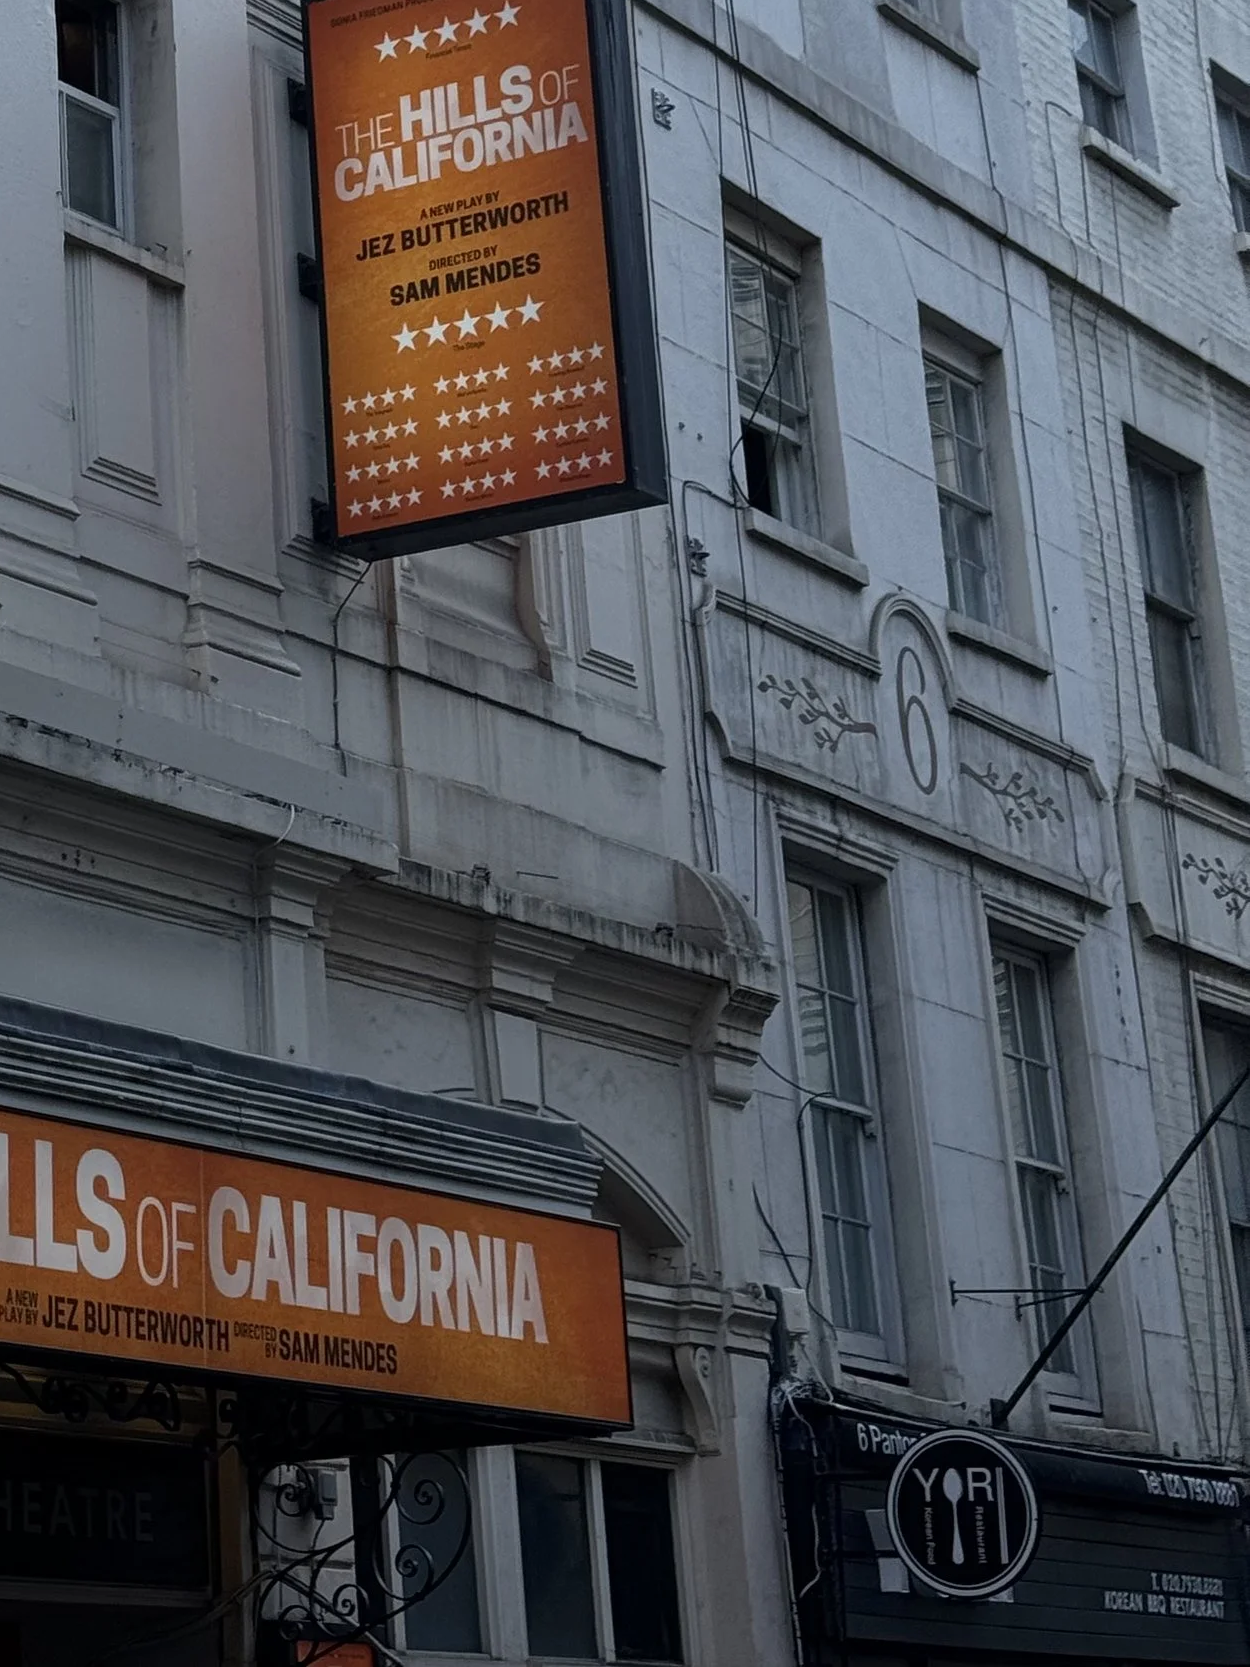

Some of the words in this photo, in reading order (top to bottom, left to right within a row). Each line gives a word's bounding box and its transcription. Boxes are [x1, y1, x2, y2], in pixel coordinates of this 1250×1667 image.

[359, 2, 405, 21] FRIEDMAN
[335, 112, 395, 157] THE
[400, 65, 534, 142] HILLS
[539, 64, 580, 106] OF
[334, 102, 589, 201] CALIFORNIA
[420, 208, 429, 221] A
[429, 202, 455, 217] NEW
[456, 195, 484, 211] PLAY
[485, 190, 500, 204] BY
[356, 233, 396, 262] JEZ
[401, 191, 569, 251] BUTTERWORTH
[429, 248, 481, 272] DIRECTED
[484, 245, 498, 258] BY
[390, 276, 440, 307] SAM
[445, 252, 541, 294] MENDES
[896, 646, 938, 795] 6
[135, 1196, 198, 1289] OF
[209, 1186, 549, 1344] CALIFORNIA
[6, 1288, 15, 1303] A
[15, 1291, 38, 1308] NEW
[25, 1309, 38, 1327] BY
[42, 1294, 80, 1333] JEZ
[84, 1301, 230, 1353] BUTTERWORTH
[234, 1321, 277, 1342] DIRECTED
[265, 1342, 277, 1359] BY
[278, 1328, 321, 1364] SAM
[324, 1337, 398, 1375] MENDES
[856, 1422, 869, 1453] 6
[923, 1506, 935, 1540] Korean
[974, 1505, 989, 1565] Restaurant
[1104, 1590, 1144, 1613] KOREAN
[1170, 1595, 1225, 1620] RESTAURANT
